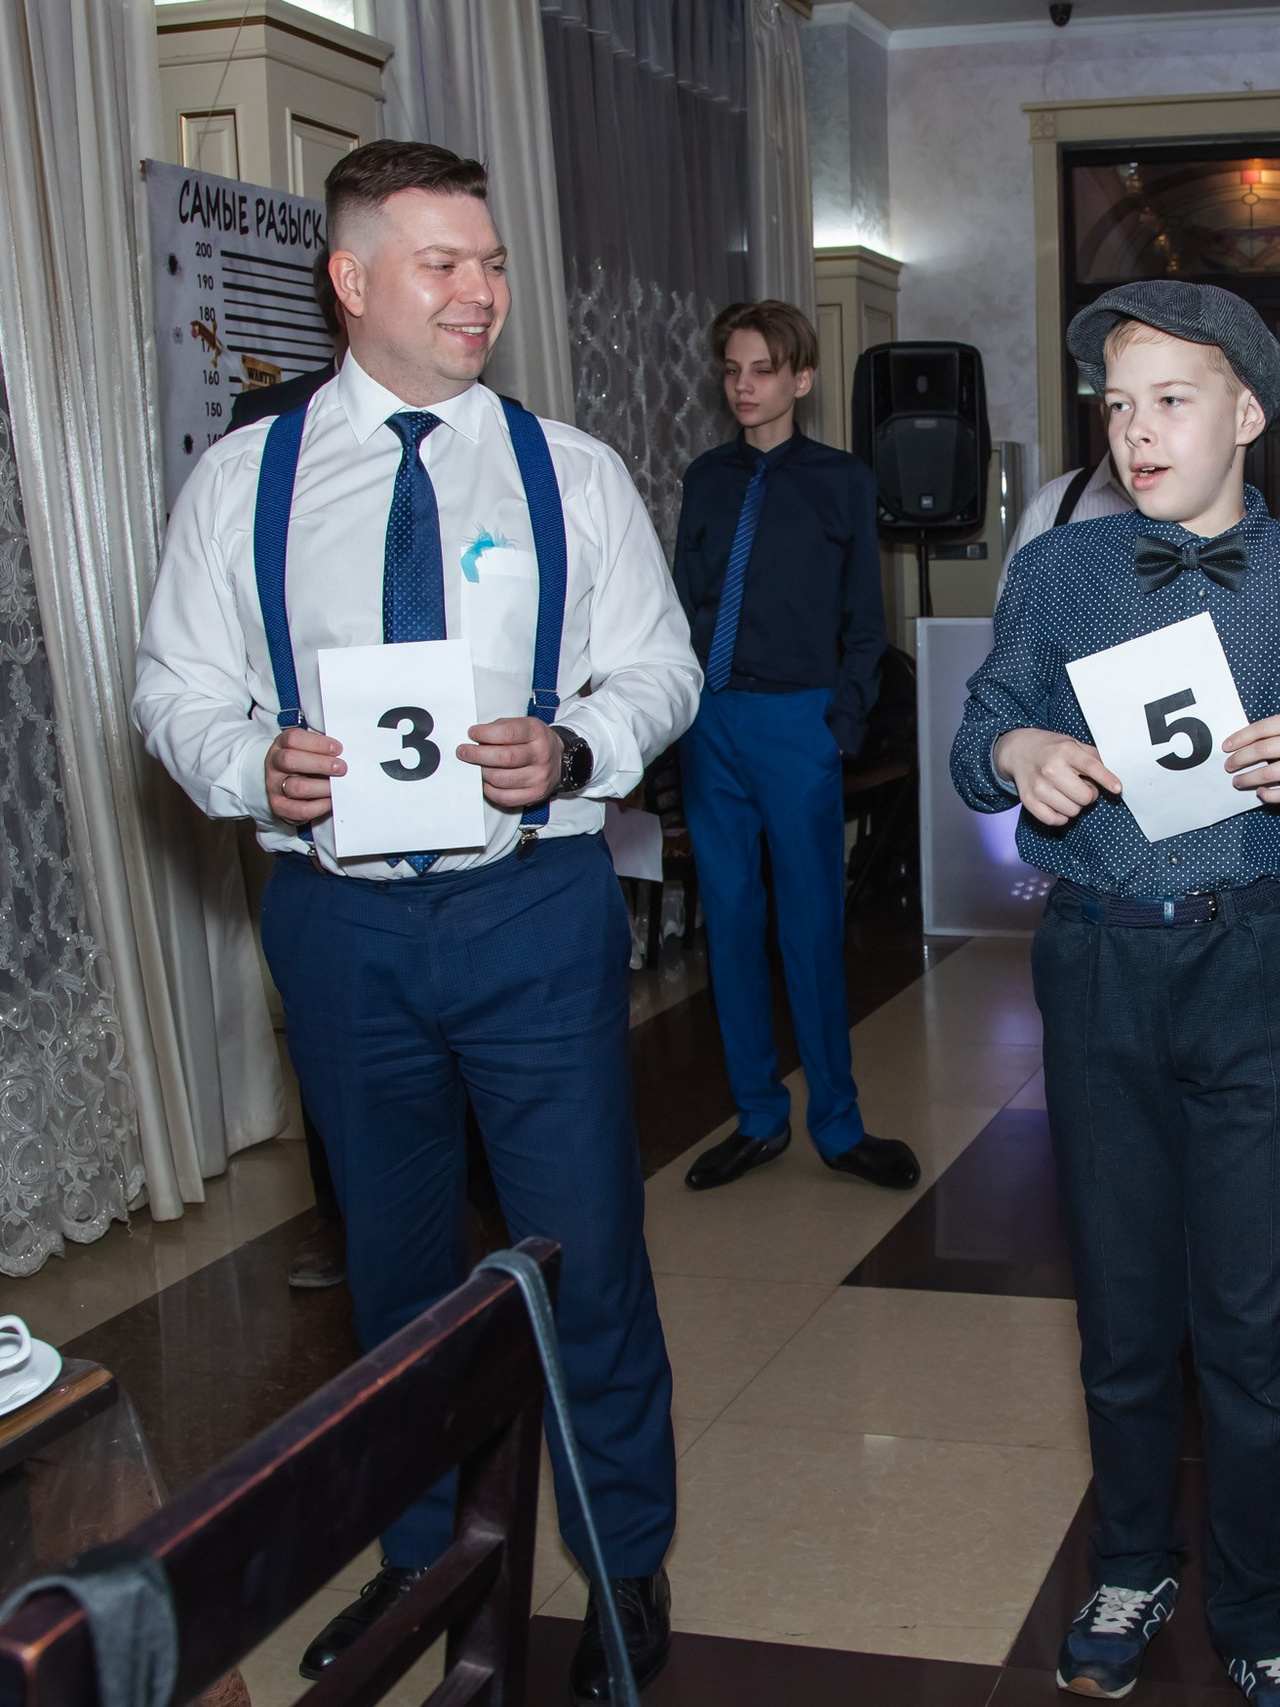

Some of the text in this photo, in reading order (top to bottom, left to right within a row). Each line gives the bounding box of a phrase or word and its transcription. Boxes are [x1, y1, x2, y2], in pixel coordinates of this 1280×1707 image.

[178, 179, 327, 250] САМЫЕ РАЗЫСК
[195, 241, 213, 258] 200
[197, 273, 215, 290] 190
[199, 306, 216, 322] 180
[202, 370, 220, 386] 160
[205, 402, 223, 418] 150
[1143, 687, 1213, 771] 5
[376, 706, 441, 782] 3
